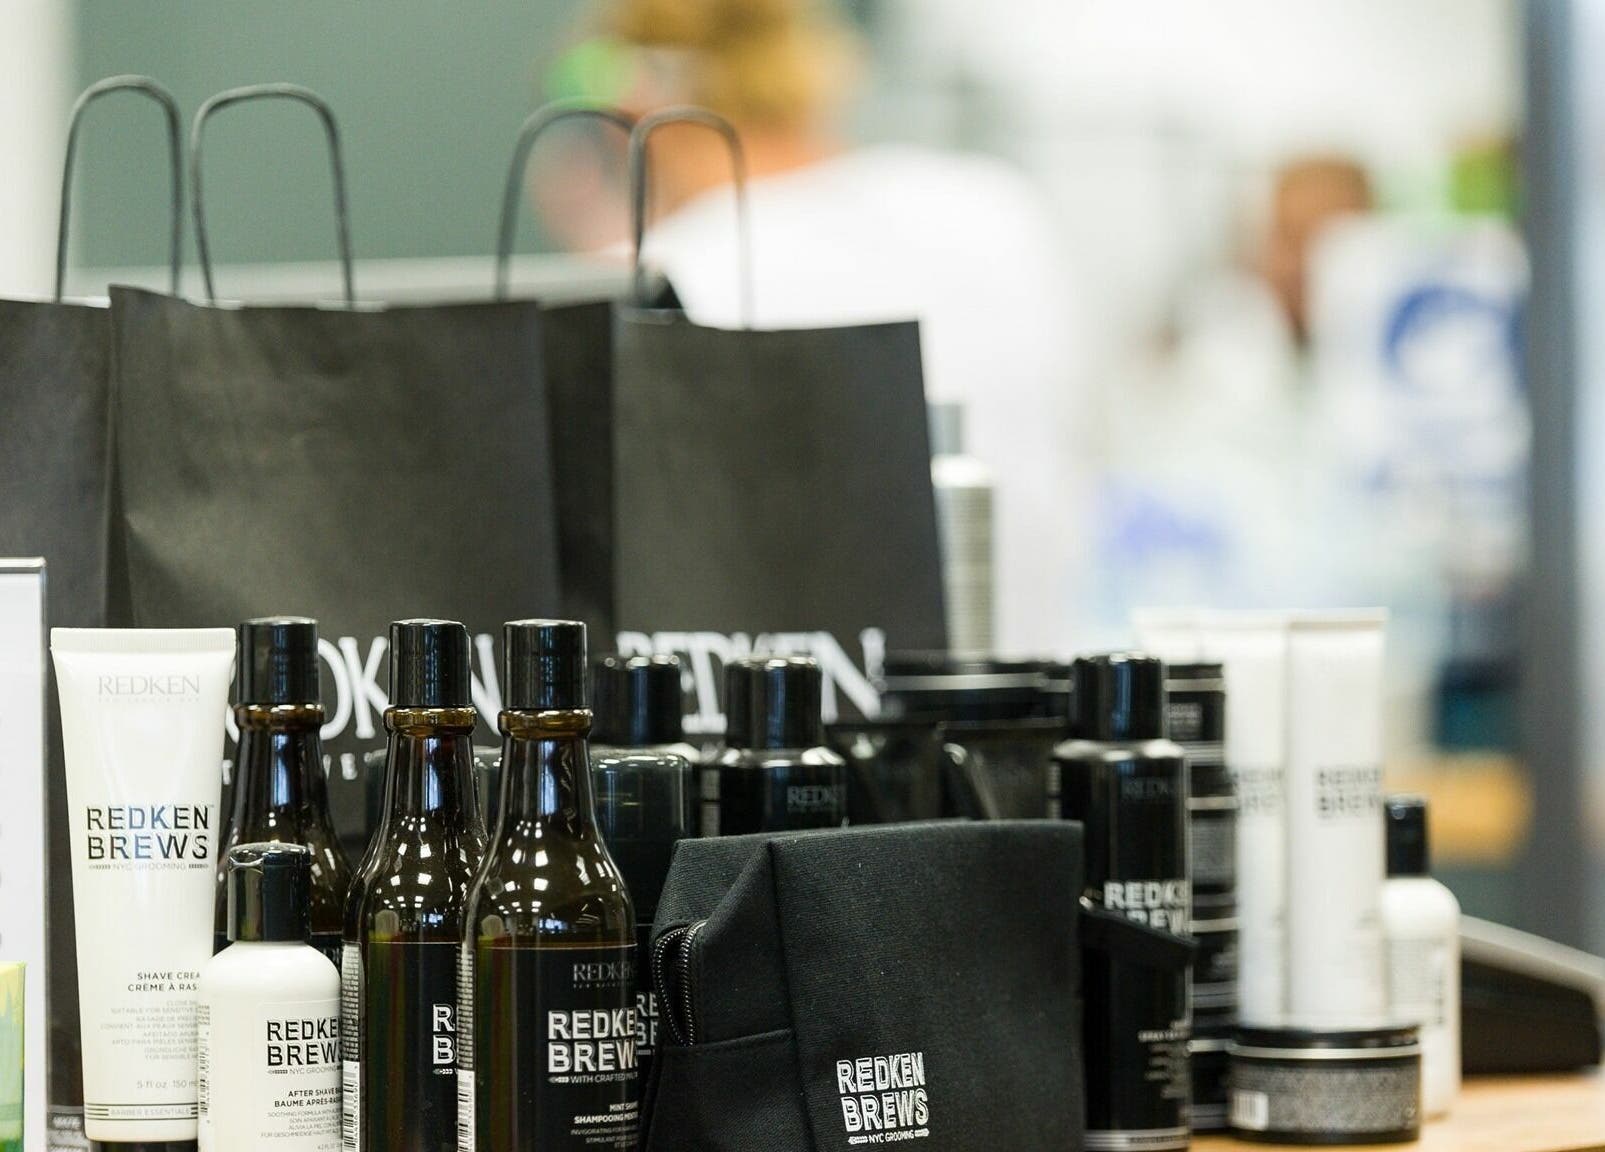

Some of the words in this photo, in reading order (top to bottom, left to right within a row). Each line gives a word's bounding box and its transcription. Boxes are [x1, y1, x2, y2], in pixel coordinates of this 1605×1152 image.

[98, 675, 200, 695] REDKEN
[87, 806, 209, 830] REDKEN
[88, 834, 208, 860] BREWS
[137, 972, 173, 980] SHAVE
[836, 1051, 925, 1094] REDKEN
[173, 1080, 187, 1088] 150
[274, 1100, 304, 1108] BAUME
[841, 1088, 929, 1132] BREWS
[574, 1113, 624, 1124] SHAMPOOING
[869, 1133, 885, 1143] NYC
[885, 1129, 914, 1142] GROOMING
